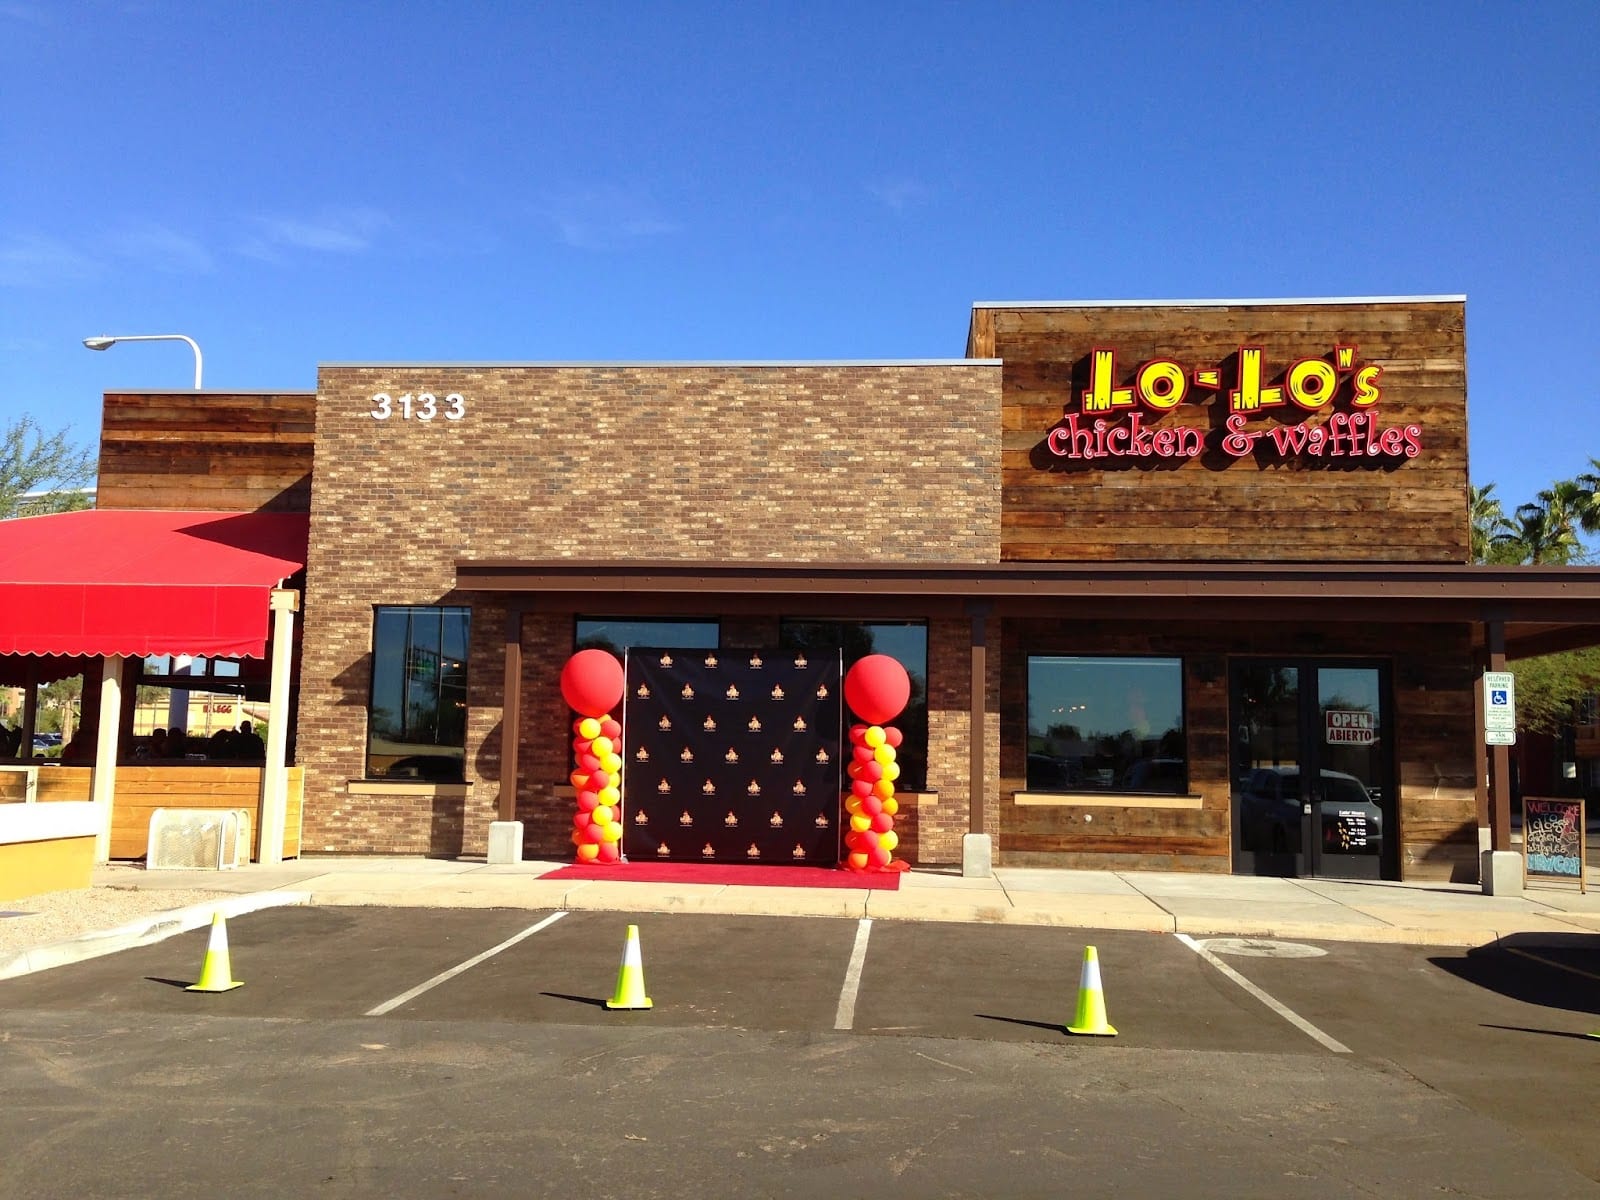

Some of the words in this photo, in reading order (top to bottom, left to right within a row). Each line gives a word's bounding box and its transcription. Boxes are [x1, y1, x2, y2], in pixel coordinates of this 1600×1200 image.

[371, 393, 465, 420] 3133
[1047, 412, 1204, 460] chicken
[1221, 411, 1263, 457] &
[1266, 410, 1423, 458] waffles
[1332, 713, 1368, 728] OPEN
[1330, 729, 1372, 742] ABIERTO
